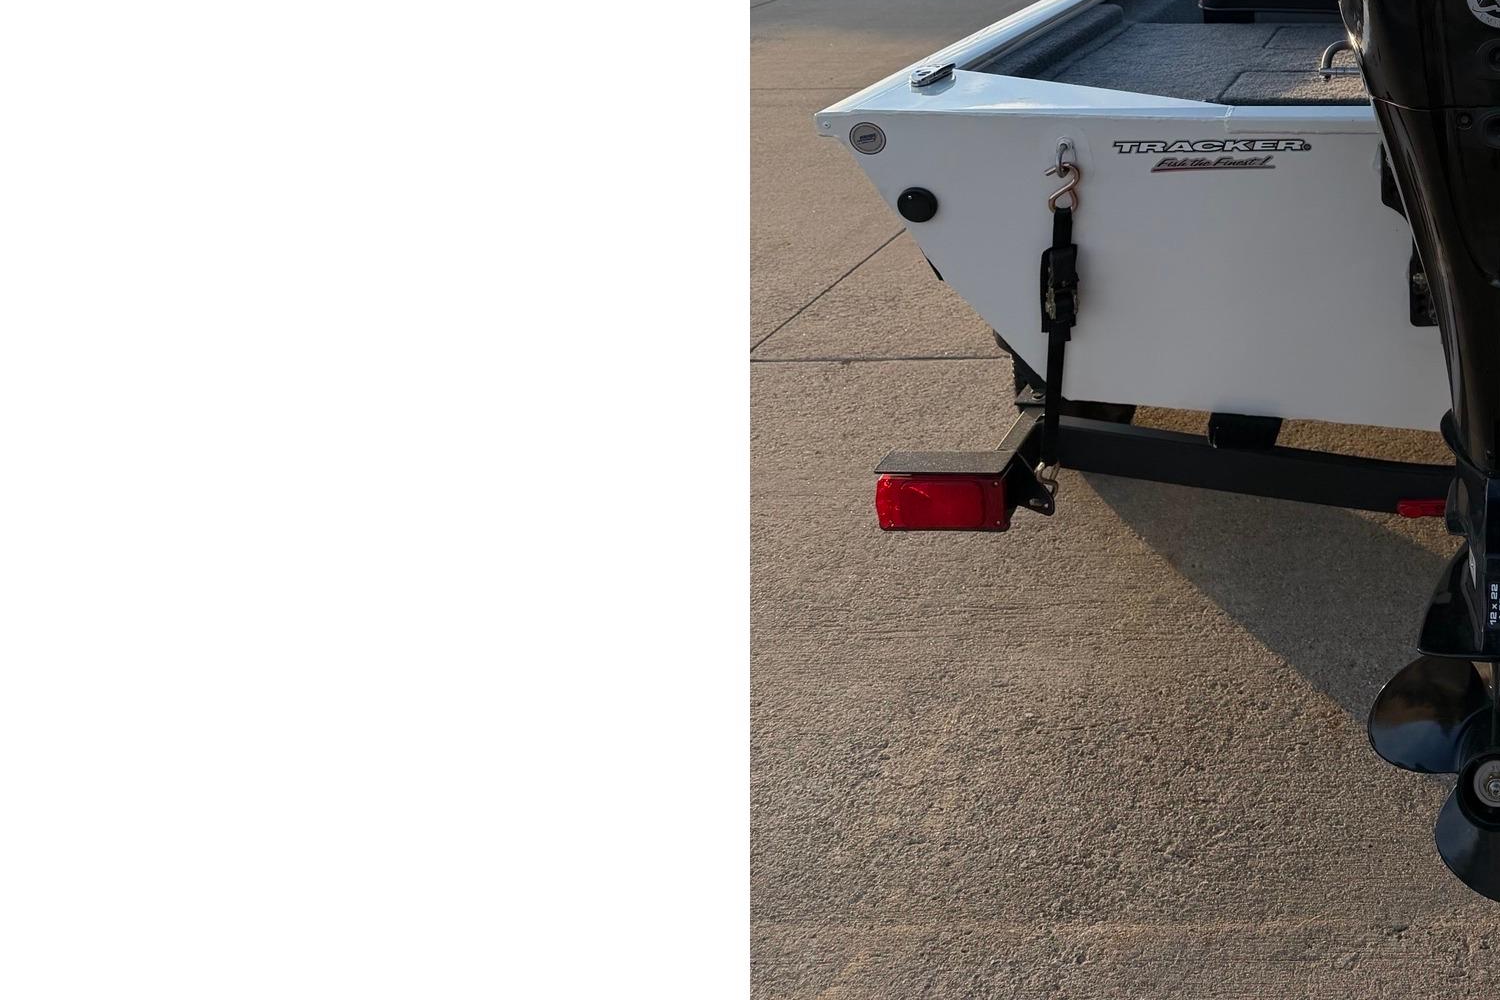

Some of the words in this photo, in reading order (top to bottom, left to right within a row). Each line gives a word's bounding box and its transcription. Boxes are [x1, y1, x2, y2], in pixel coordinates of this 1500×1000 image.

[1157, 156, 1188, 168] Fish
[1189, 156, 1210, 168] the
[1490, 584, 1498, 599] 22
[1489, 611, 1497, 625] 12
